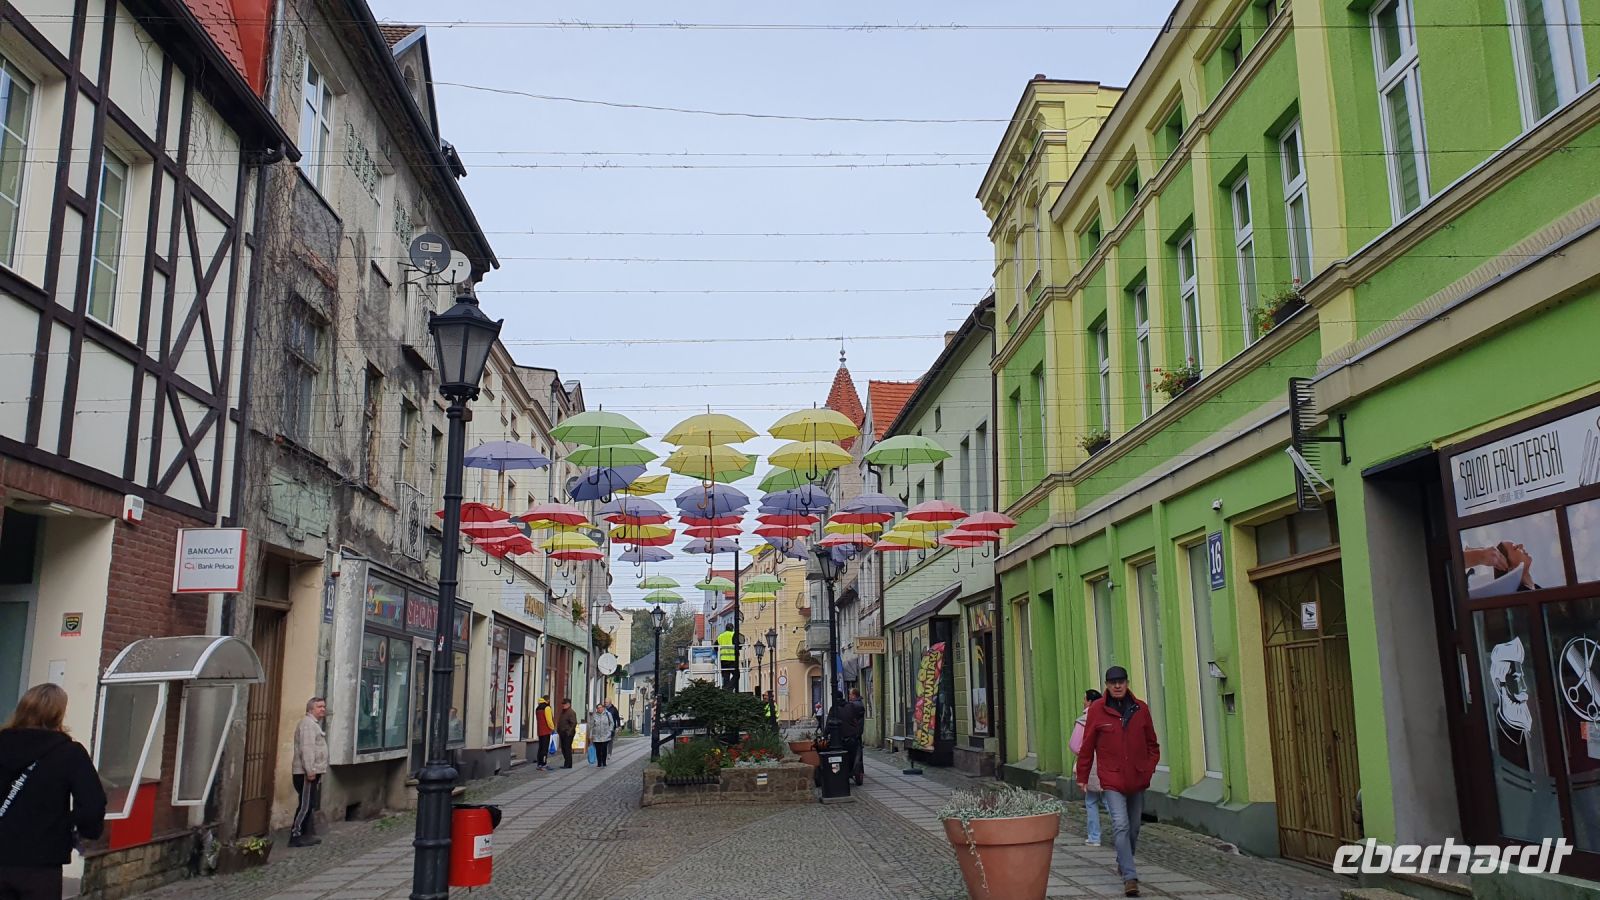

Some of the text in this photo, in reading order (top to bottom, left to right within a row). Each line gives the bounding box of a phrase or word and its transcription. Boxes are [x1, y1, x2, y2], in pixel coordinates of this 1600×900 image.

[1459, 430, 1564, 501] SALON FRYZJERSKI
[187, 547, 234, 555] BANKOMAT
[1211, 541, 1222, 574] 16
[327, 584, 335, 610] 13
[920, 651, 939, 747] WARZYWNIAK
